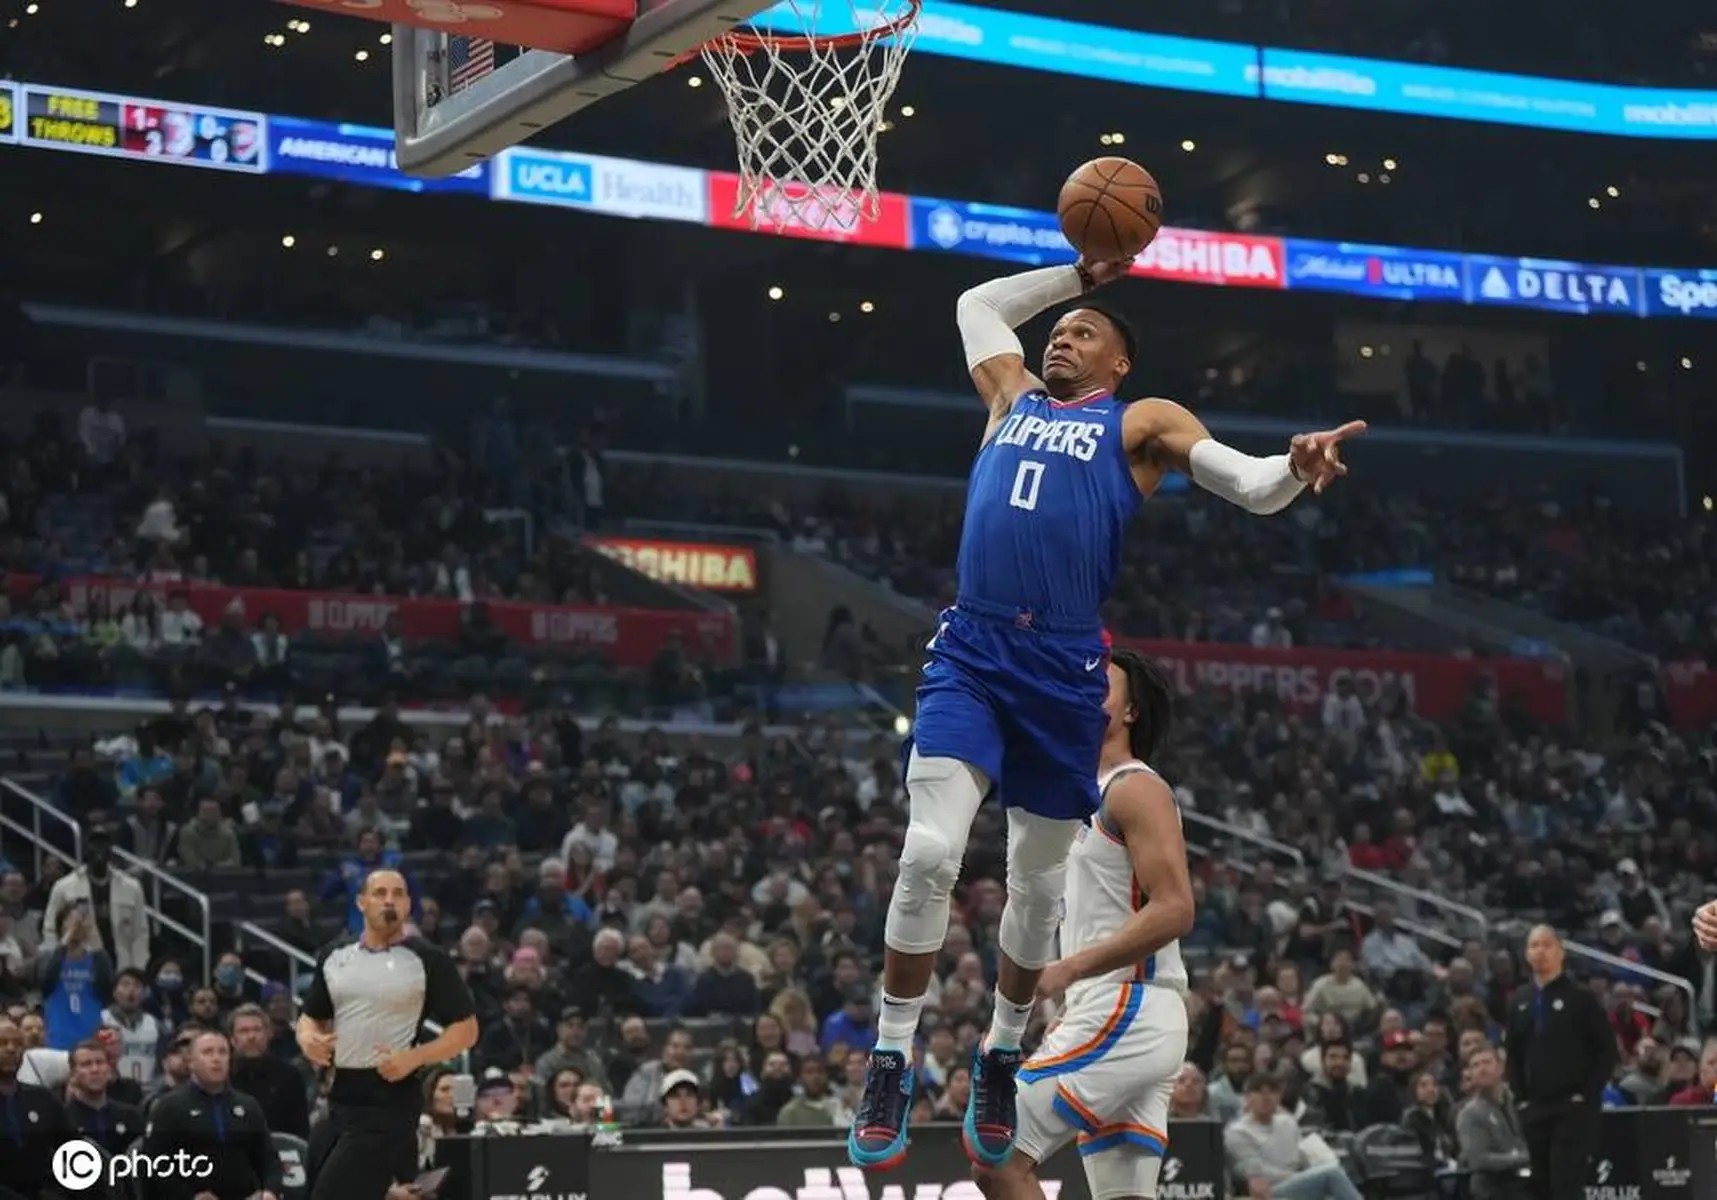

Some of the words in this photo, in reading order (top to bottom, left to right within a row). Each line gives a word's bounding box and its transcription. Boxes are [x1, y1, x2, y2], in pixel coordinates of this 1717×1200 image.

[47, 94, 99, 121] FREE
[31, 117, 117, 147] THROWS
[278, 136, 388, 169] AMERICAN
[518, 163, 587, 195] UCLA
[603, 171, 697, 210] Health
[1135, 237, 1277, 280] SHIBA
[1383, 260, 1460, 289] ULTRA
[1516, 269, 1630, 307] DELTA
[995, 413, 1105, 462] CLIPPERS
[1010, 460, 1046, 511] 0
[1583, 1185, 1641, 1200] TARLUX
